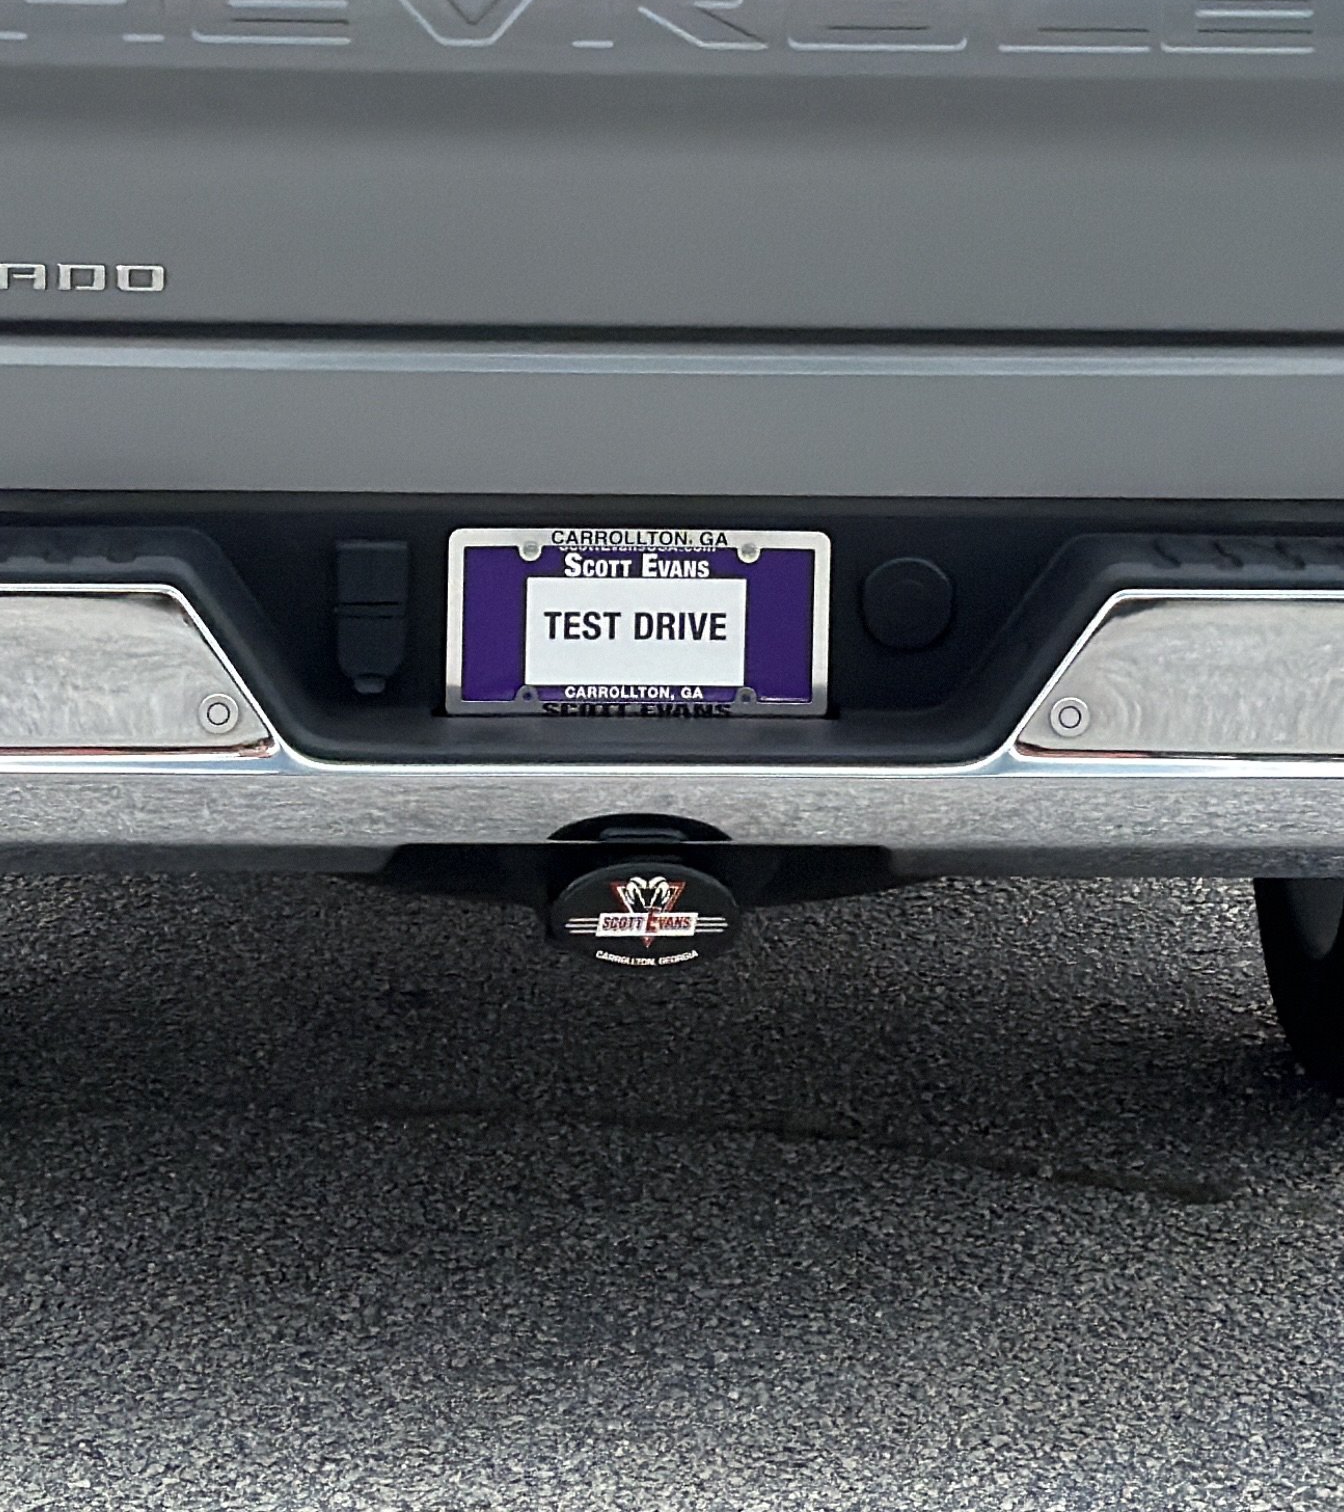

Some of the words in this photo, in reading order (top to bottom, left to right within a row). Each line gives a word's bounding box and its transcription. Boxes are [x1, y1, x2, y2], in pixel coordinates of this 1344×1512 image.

[699, 531, 728, 546] GA
[564, 552, 632, 578] SCOTT
[641, 552, 710, 578] EVANS
[544, 611, 621, 640] TEST
[634, 611, 727, 641] DRIVE
[564, 686, 675, 700] CARROLLTON,
[680, 686, 703, 699] GA
[602, 916, 645, 932] SCOTT
[645, 908, 691, 934] EVANS
